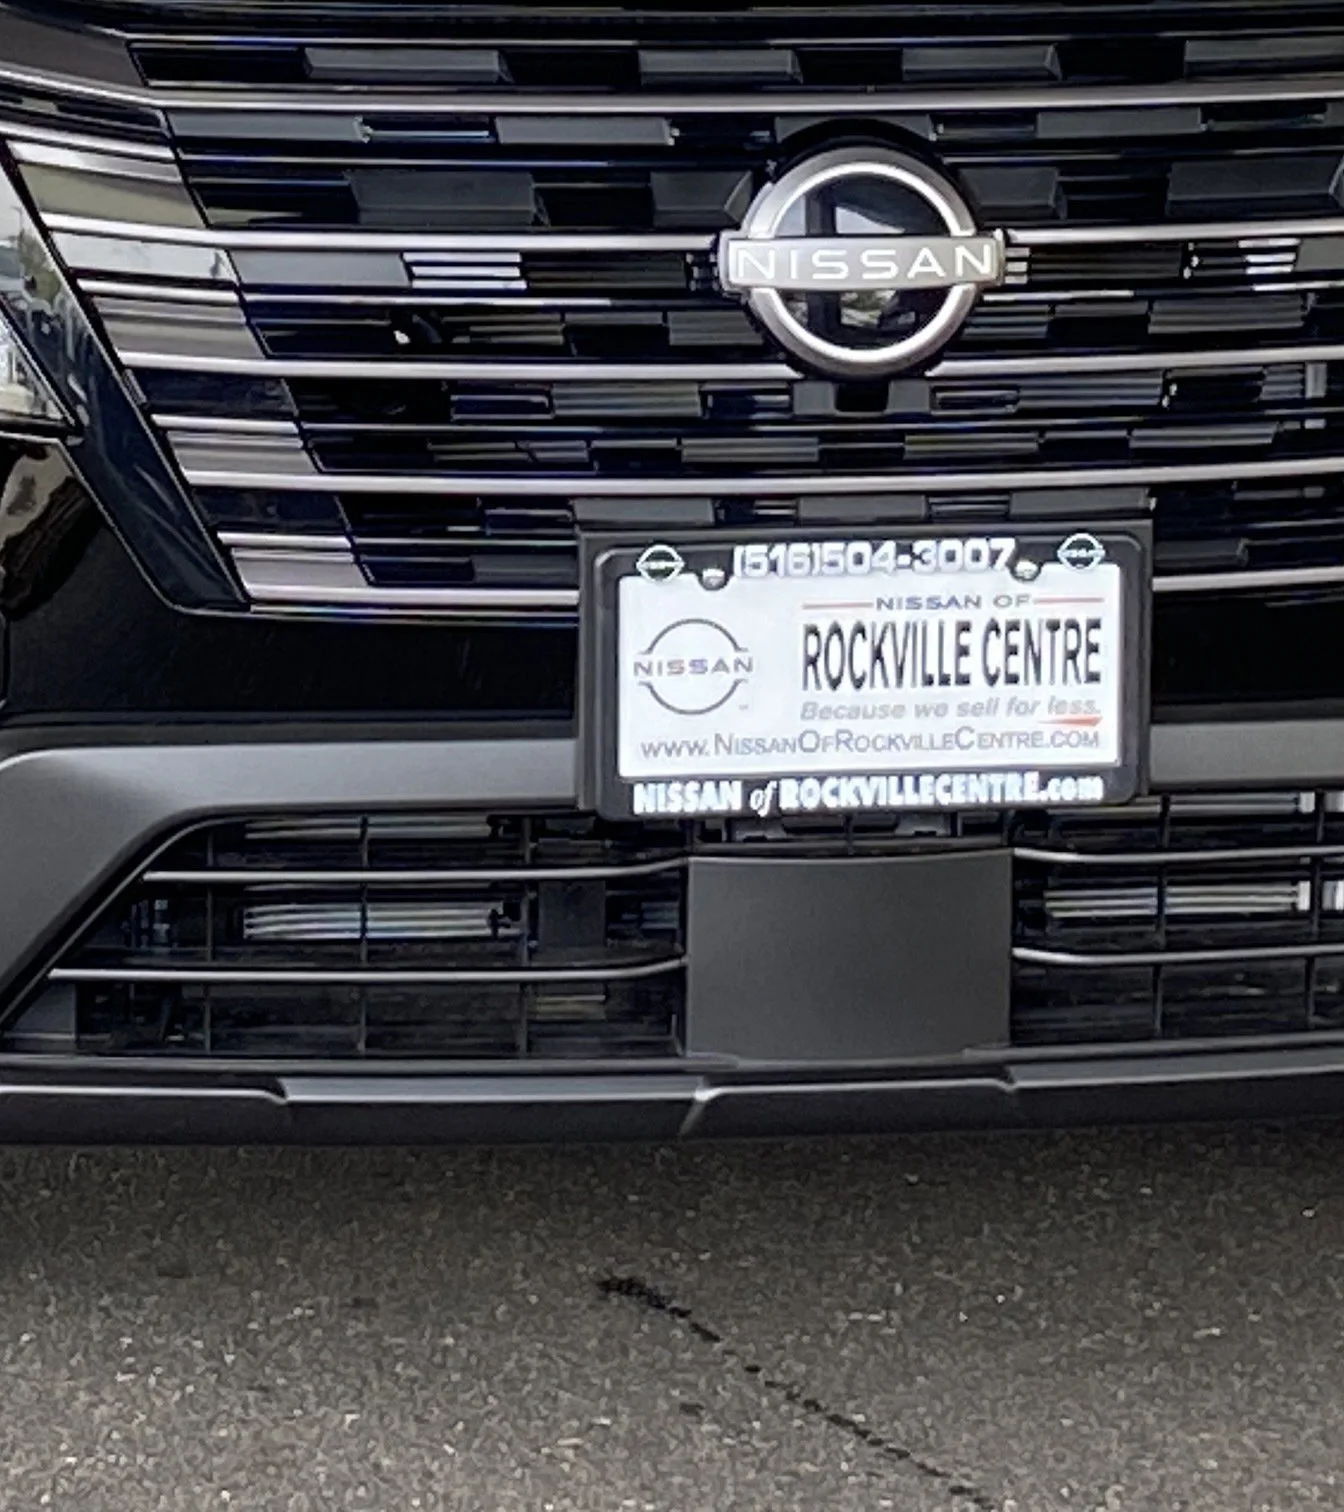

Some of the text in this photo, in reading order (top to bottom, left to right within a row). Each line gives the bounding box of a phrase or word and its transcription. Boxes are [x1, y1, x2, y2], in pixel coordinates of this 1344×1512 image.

[737, 244, 992, 281] NISSAN
[876, 592, 1032, 611] NISSAN OF
[633, 655, 754, 678] NISSAN
[802, 617, 1103, 691] ROCKVILLE CENTRE
[800, 694, 1102, 721] Because we sell for less.
[633, 771, 1104, 819] NISSAN of ROCKVILLECENTRE.com
